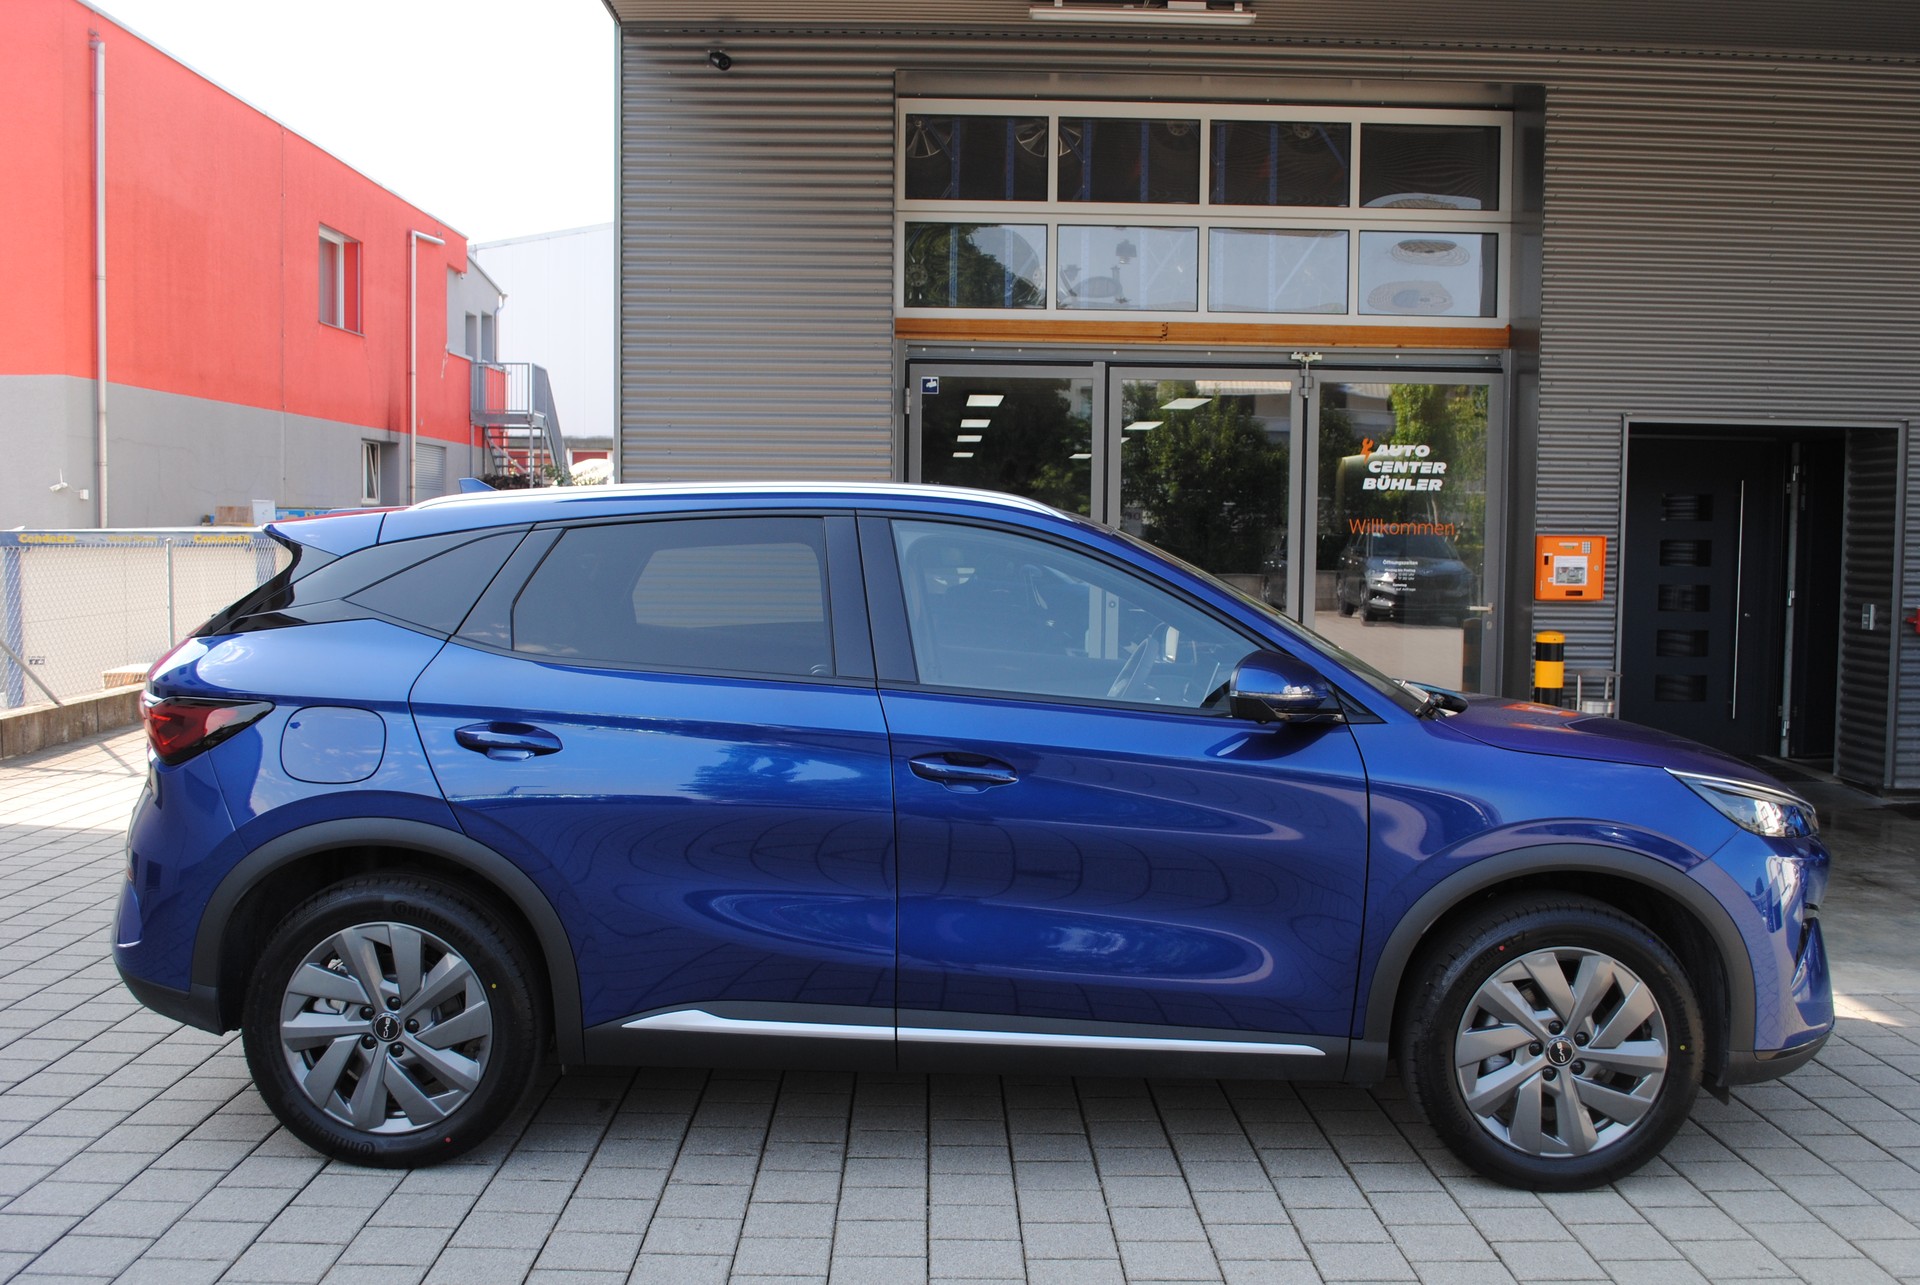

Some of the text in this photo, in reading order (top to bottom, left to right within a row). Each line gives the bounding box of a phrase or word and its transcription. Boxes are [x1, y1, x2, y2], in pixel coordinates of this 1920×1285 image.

[1375, 444, 1431, 458] AUTO
[1368, 460, 1447, 474] CENTER
[1362, 474, 1443, 491] BÜHLER
[1349, 518, 1455, 535] Willkommen
